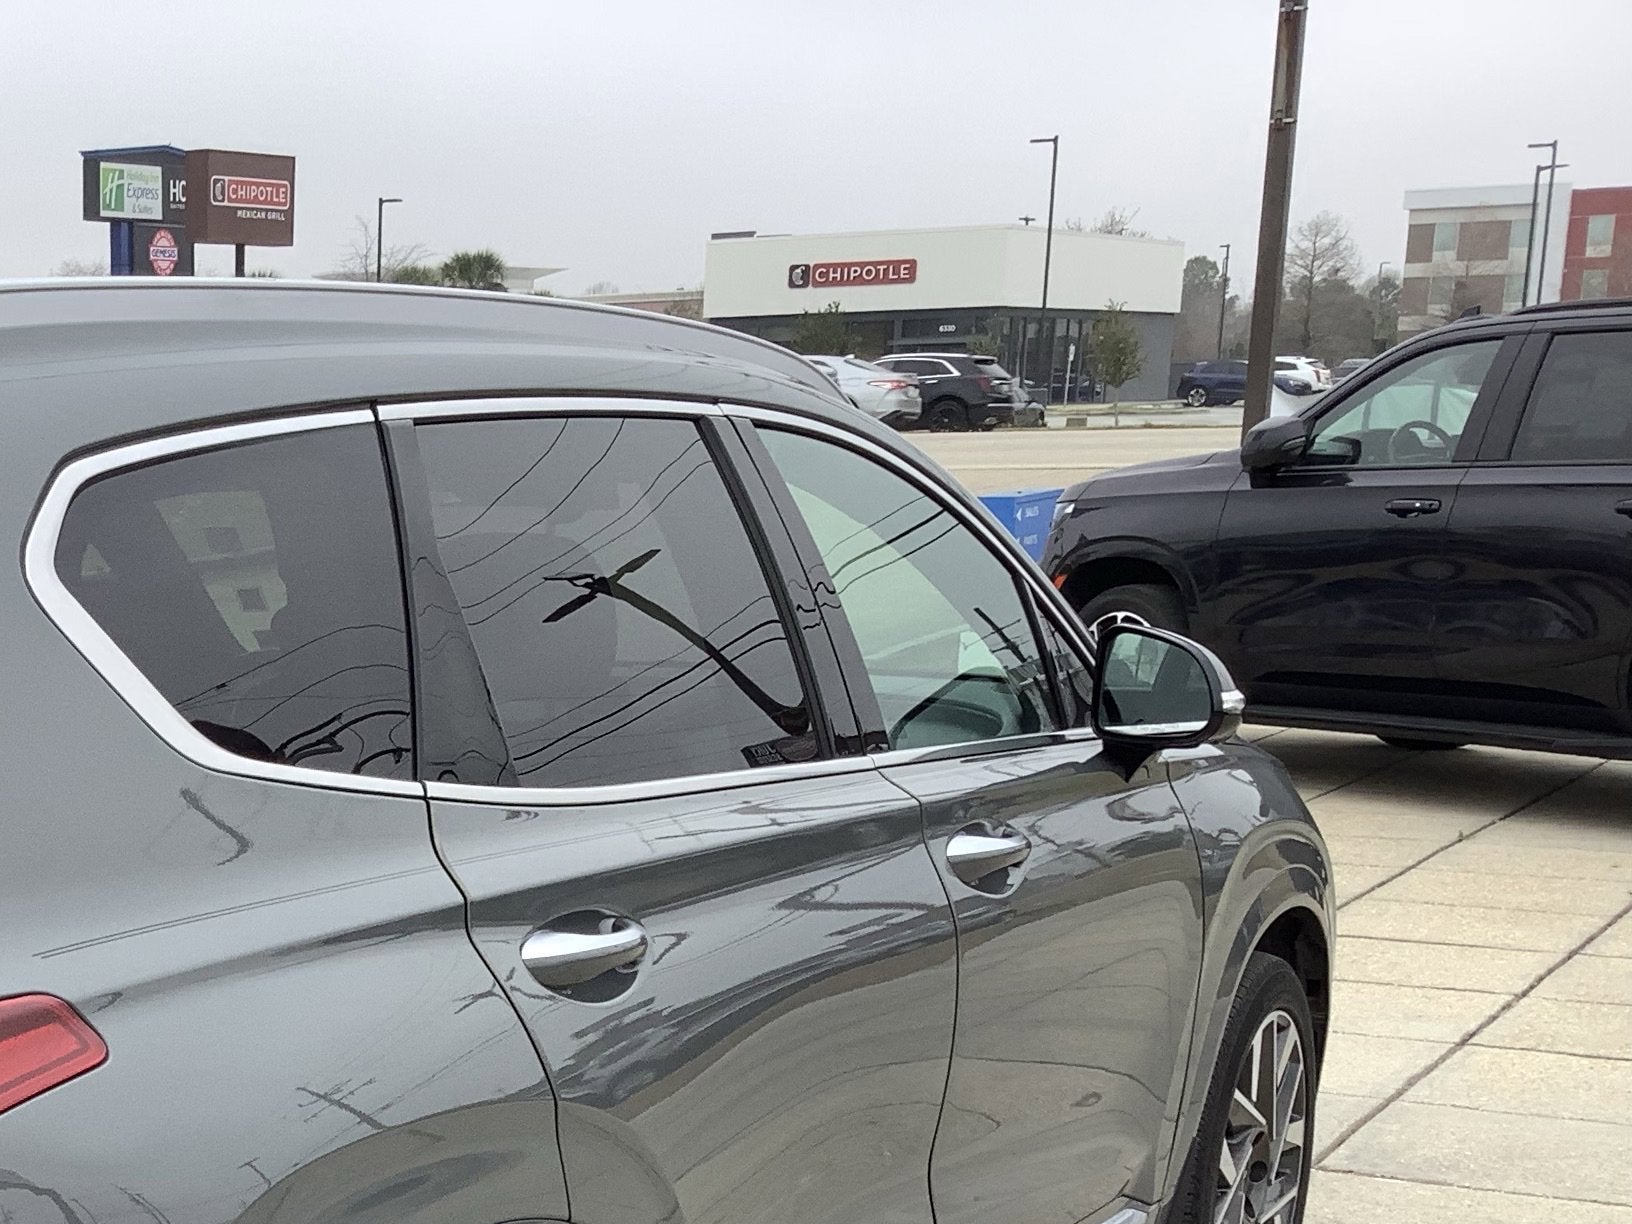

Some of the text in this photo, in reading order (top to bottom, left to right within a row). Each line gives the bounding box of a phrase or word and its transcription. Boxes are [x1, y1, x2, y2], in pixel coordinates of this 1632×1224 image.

[127, 183, 159, 202] Express
[229, 184, 286, 202] CHIPOTLE
[236, 209, 286, 221] MEXICAN GRILL
[814, 263, 911, 282] CHIPOTLE
